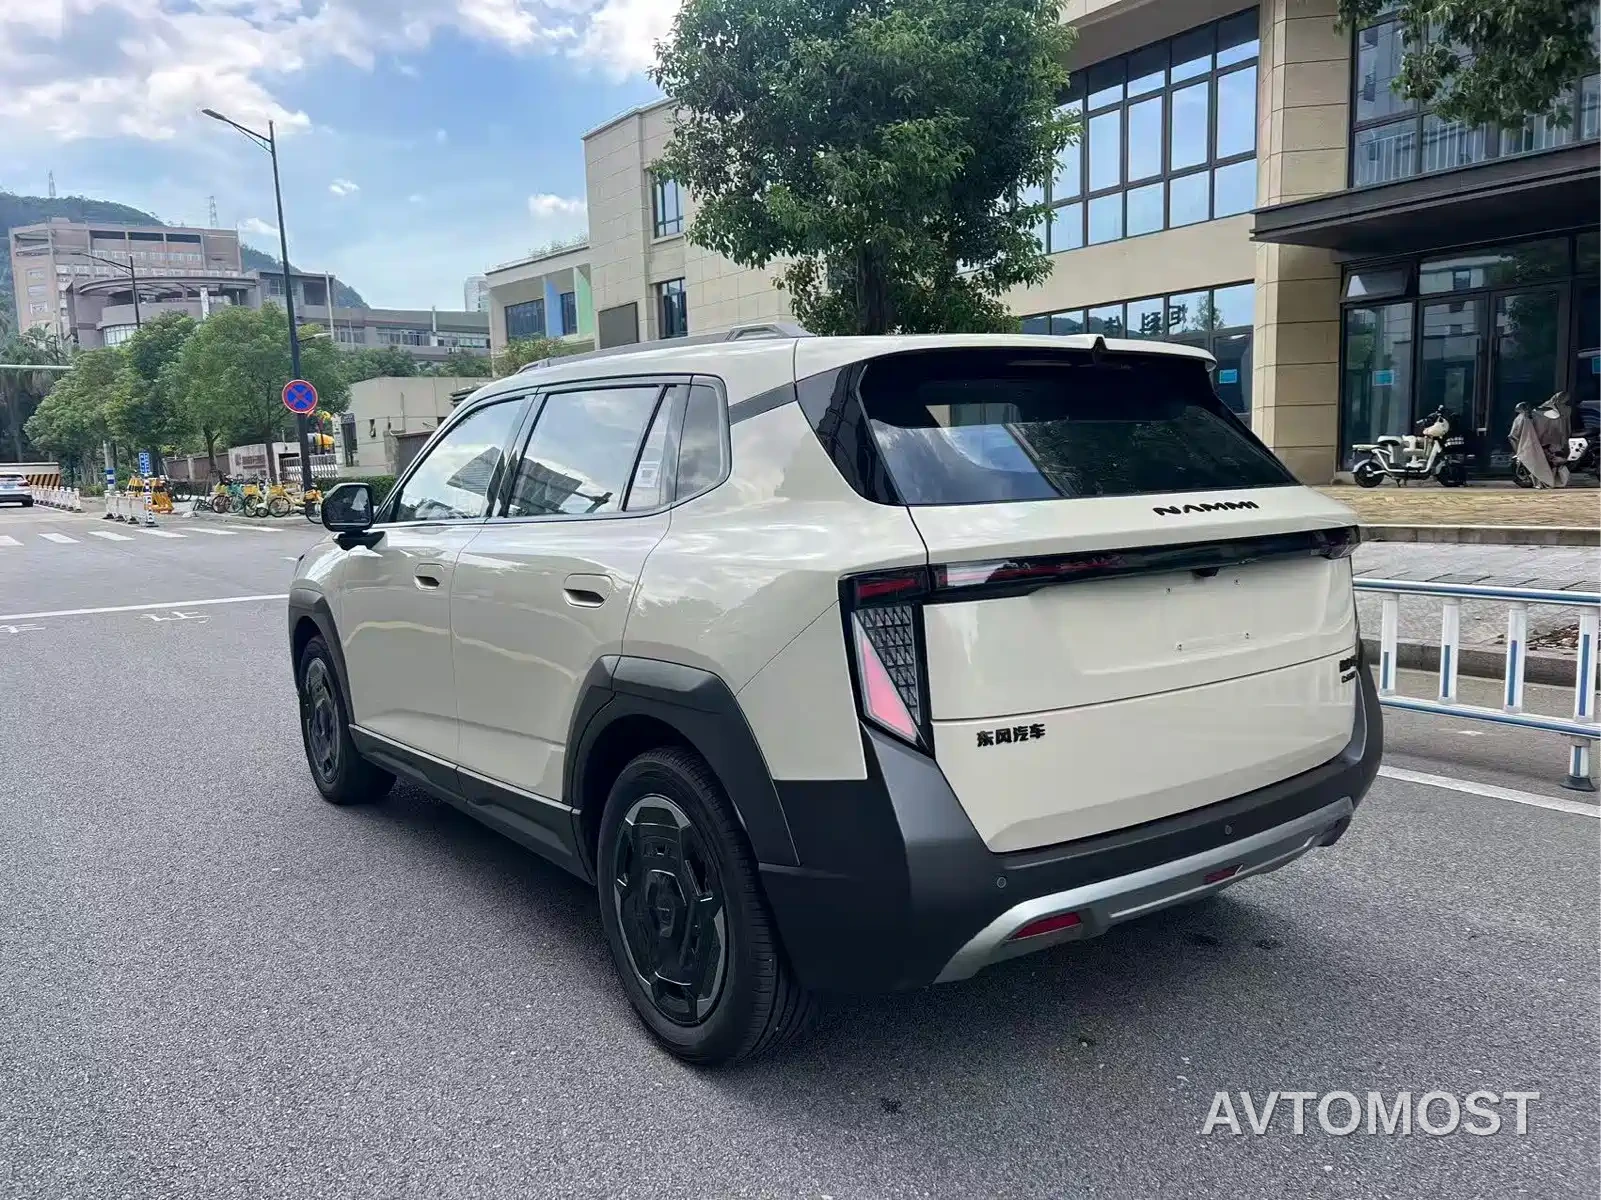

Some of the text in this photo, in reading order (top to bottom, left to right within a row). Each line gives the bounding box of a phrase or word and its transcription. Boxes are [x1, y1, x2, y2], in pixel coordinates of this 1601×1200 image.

[1153, 501, 1260, 516] NAMMI
[976, 723, 1046, 748] 东风汽车
